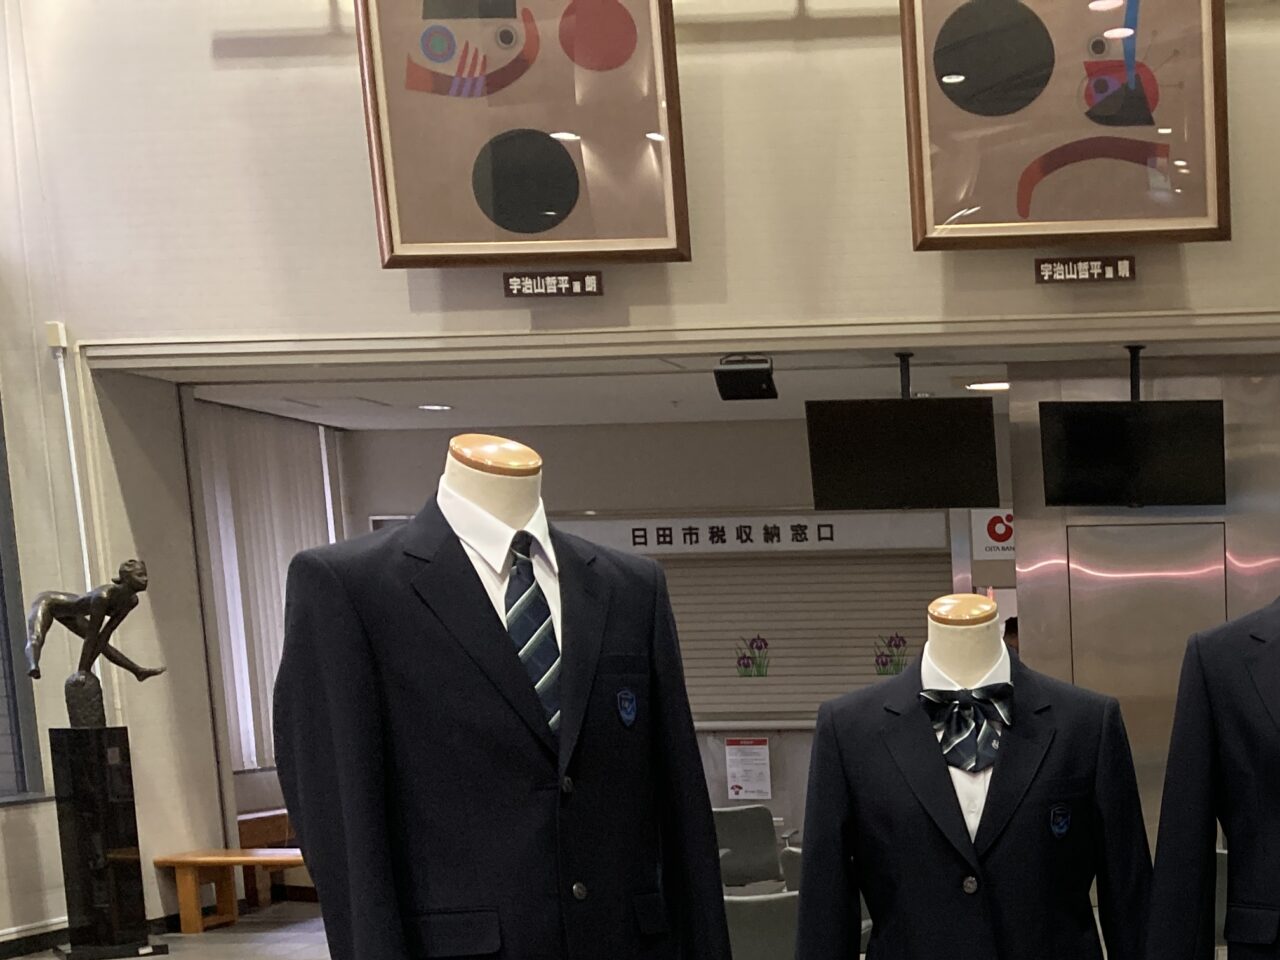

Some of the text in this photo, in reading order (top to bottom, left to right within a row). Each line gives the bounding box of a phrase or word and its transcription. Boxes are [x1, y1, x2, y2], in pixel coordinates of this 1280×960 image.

[631, 523, 835, 547] 日田市税収納窓口
